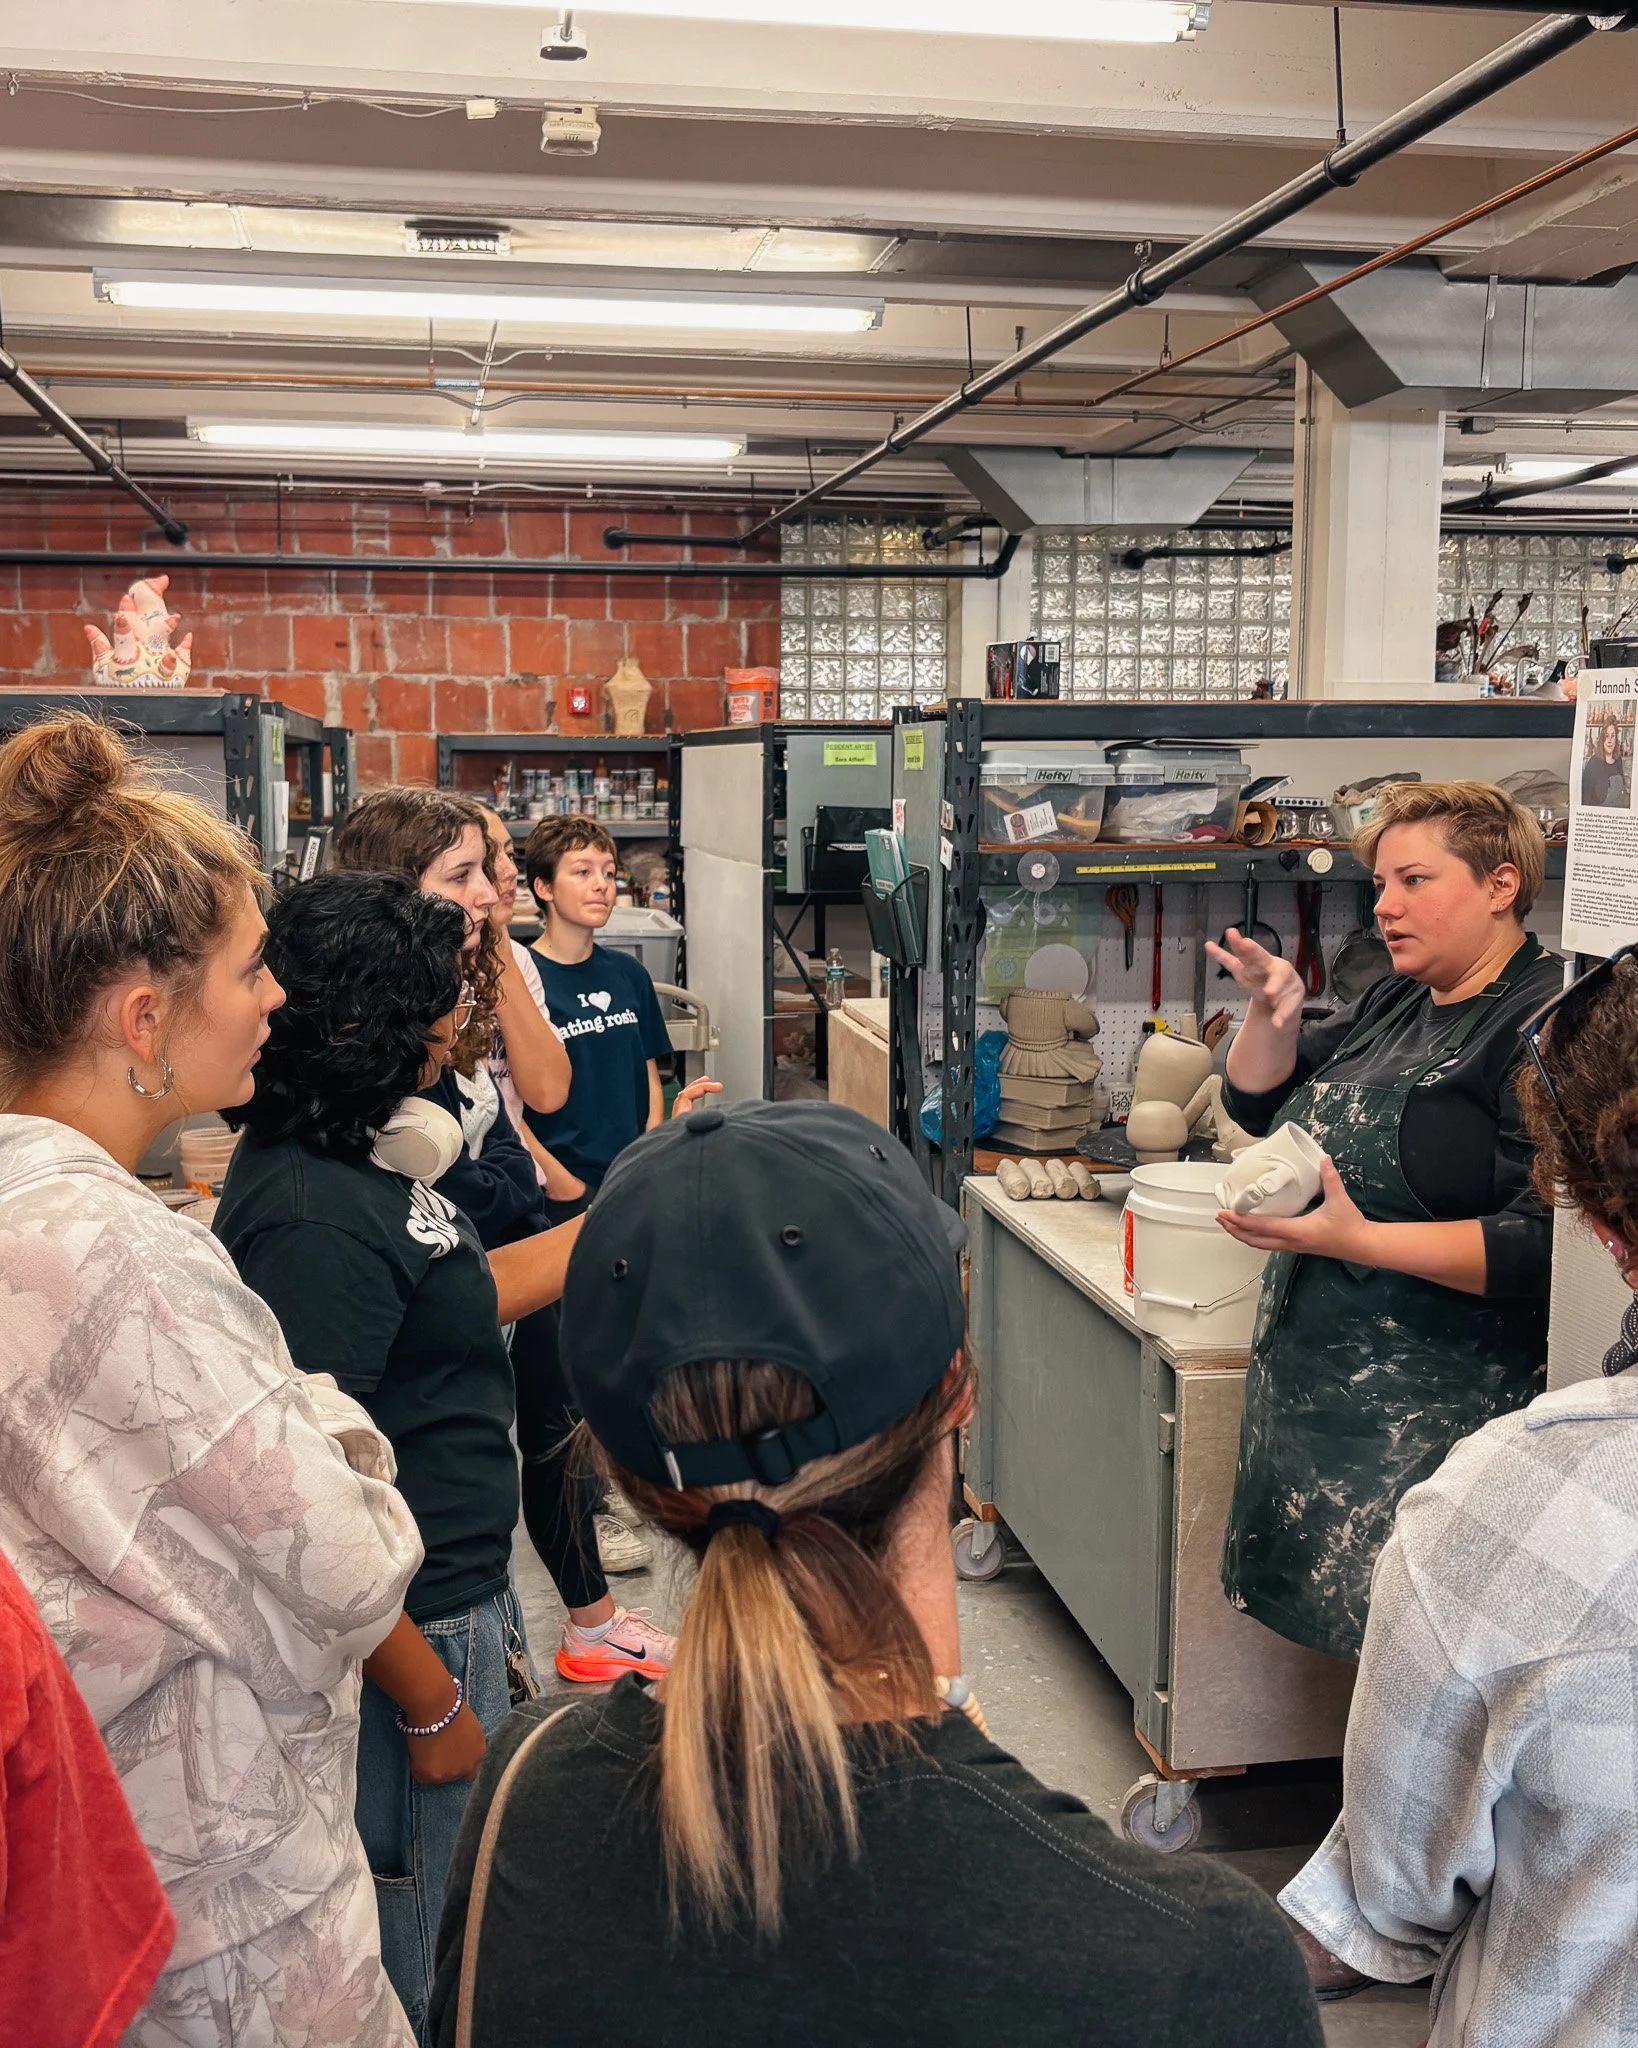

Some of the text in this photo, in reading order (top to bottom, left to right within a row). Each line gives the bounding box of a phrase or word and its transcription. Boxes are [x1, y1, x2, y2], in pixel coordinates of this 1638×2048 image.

[1594, 677, 1630, 694] Hannah
[1037, 770, 1069, 782] Hefty
[1175, 769, 1206, 781] Hefty
[577, 994, 589, 1007] I
[558, 1015, 605, 1040] ating
